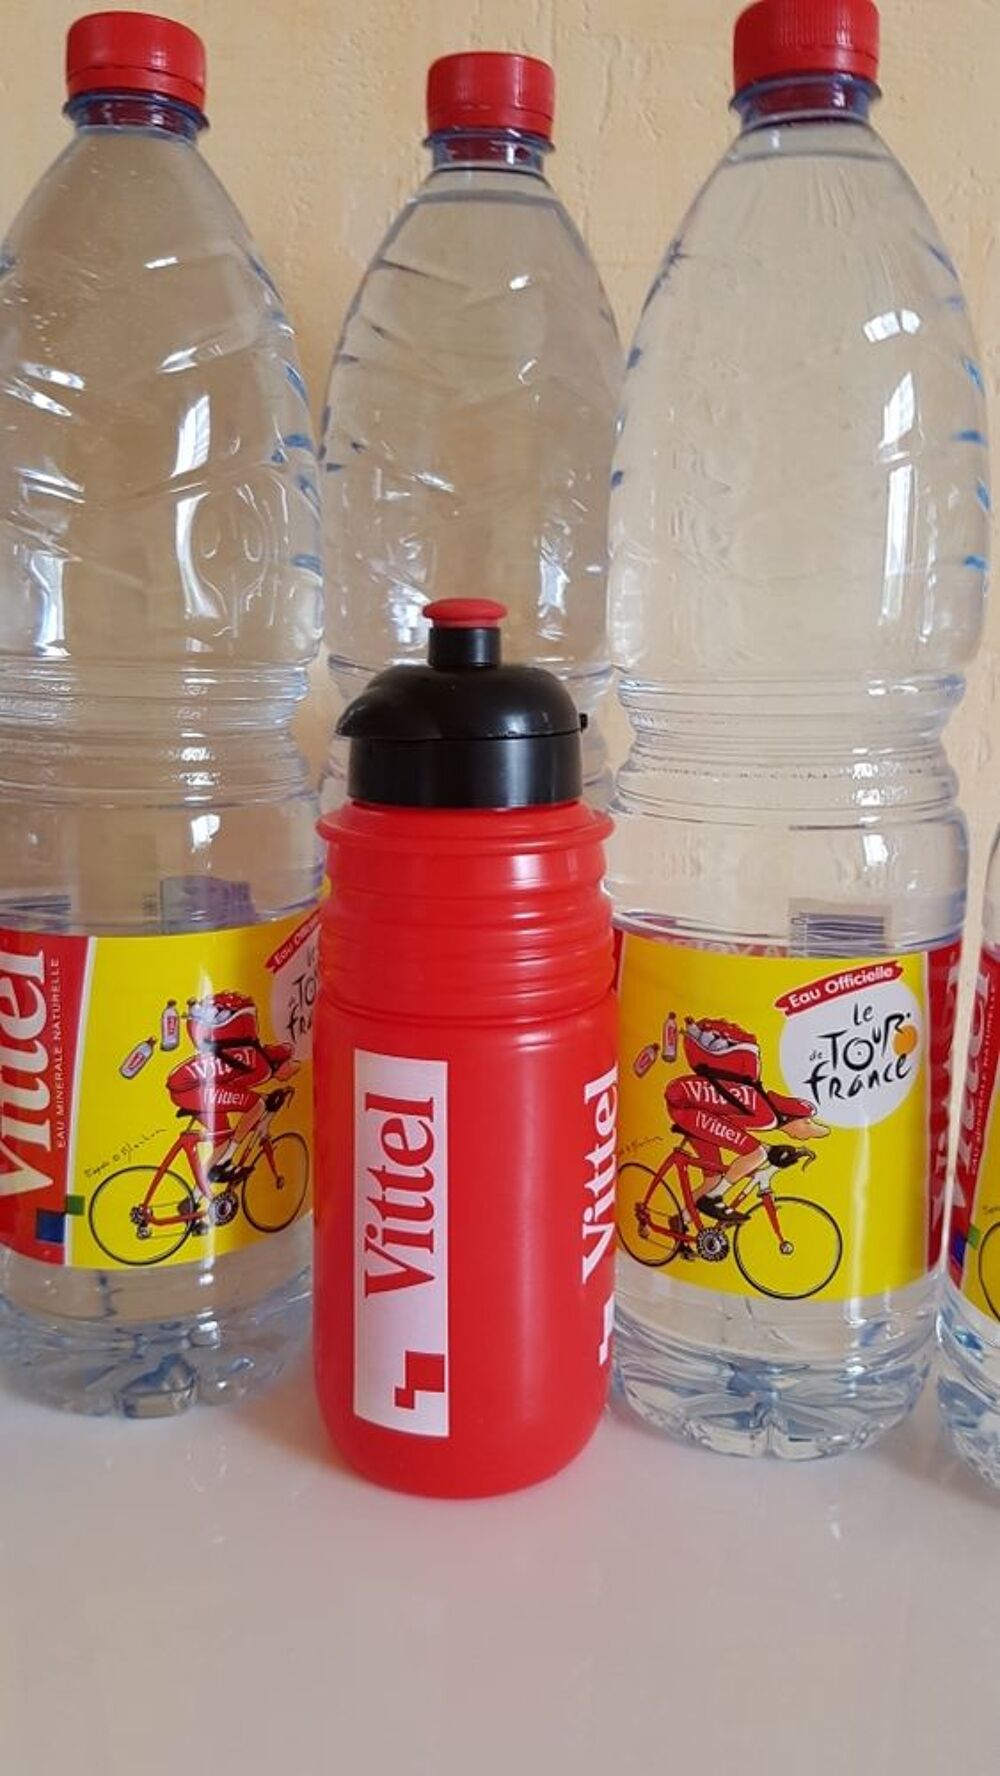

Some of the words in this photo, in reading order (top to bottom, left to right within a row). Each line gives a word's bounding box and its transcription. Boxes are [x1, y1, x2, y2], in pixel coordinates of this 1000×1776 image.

[50, 957, 63, 1042] NATURELLE
[788, 988, 821, 1008] Eau
[825, 965, 894, 993] Officielle
[53, 1046, 66, 1116] MINERALE
[56, 1119, 67, 1149] EAU
[699, 1113, 742, 1145] Vittel
[364, 1092, 435, 1298] Vittel
[582, 1062, 618, 1284] Vittel
